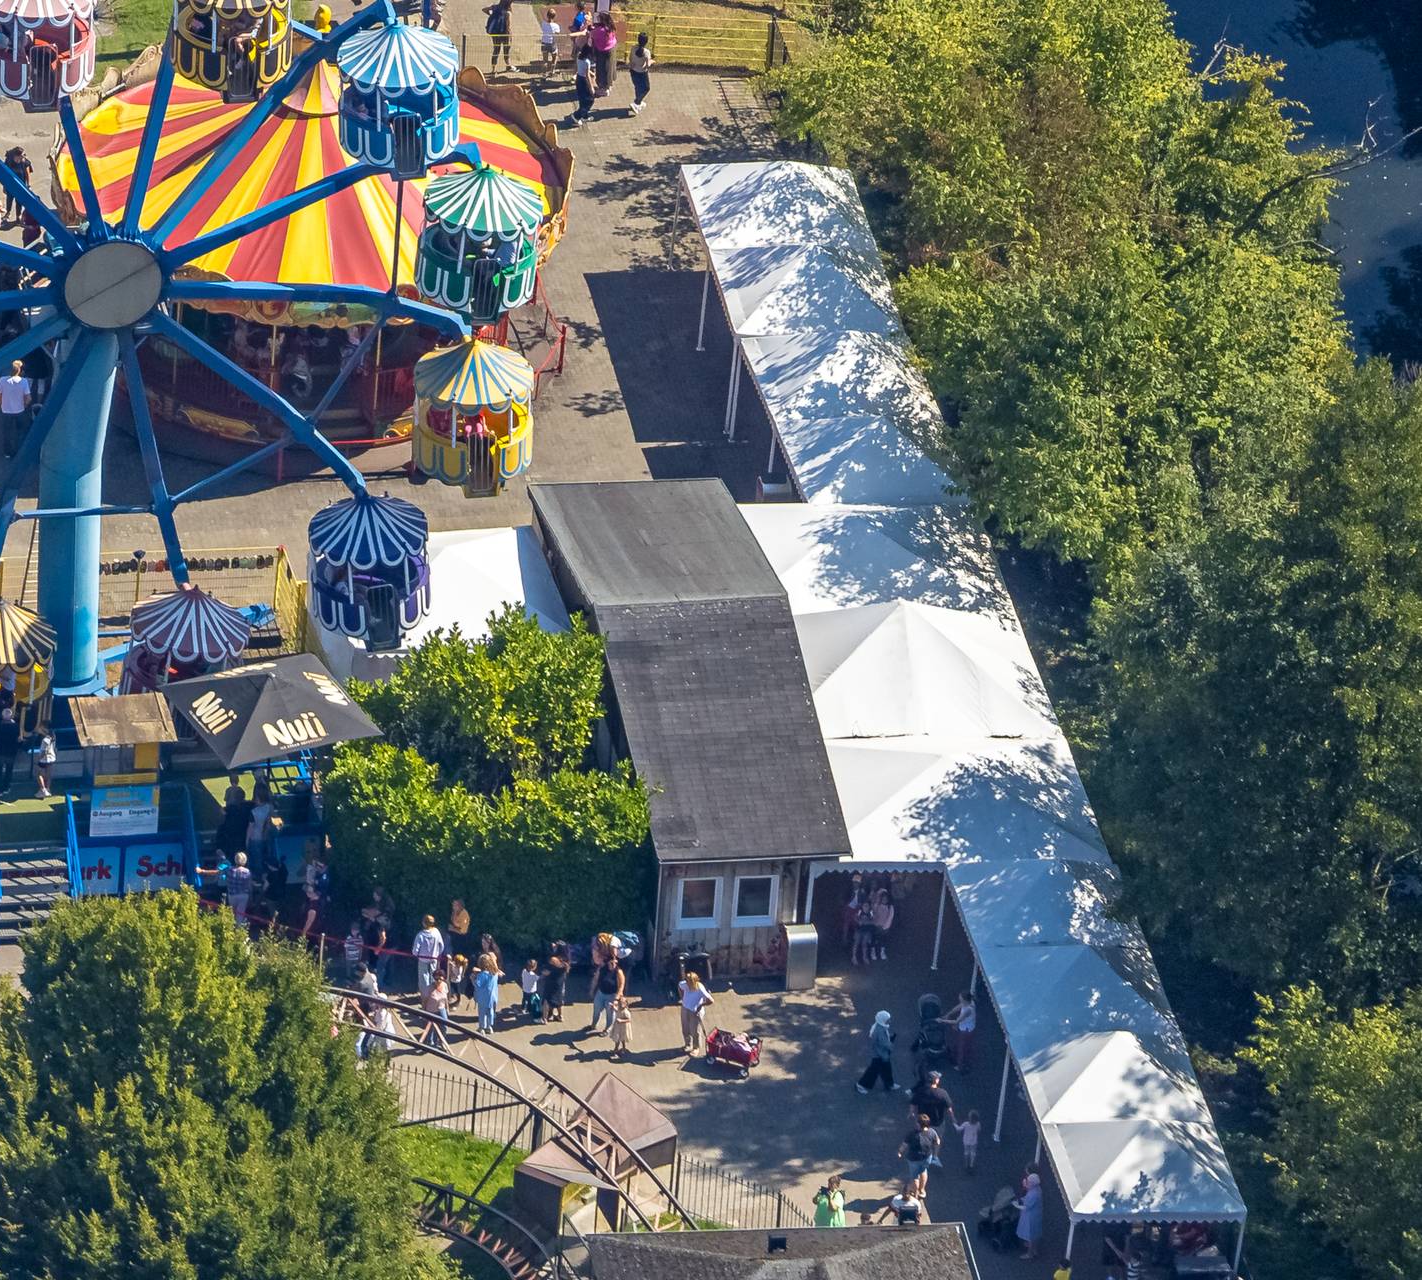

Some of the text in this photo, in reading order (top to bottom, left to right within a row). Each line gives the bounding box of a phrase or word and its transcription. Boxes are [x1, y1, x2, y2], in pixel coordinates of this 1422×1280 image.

[192, 691, 237, 736] Nuii
[262, 712, 327, 746] Nuii
[99, 810, 123, 818] Ausgang
